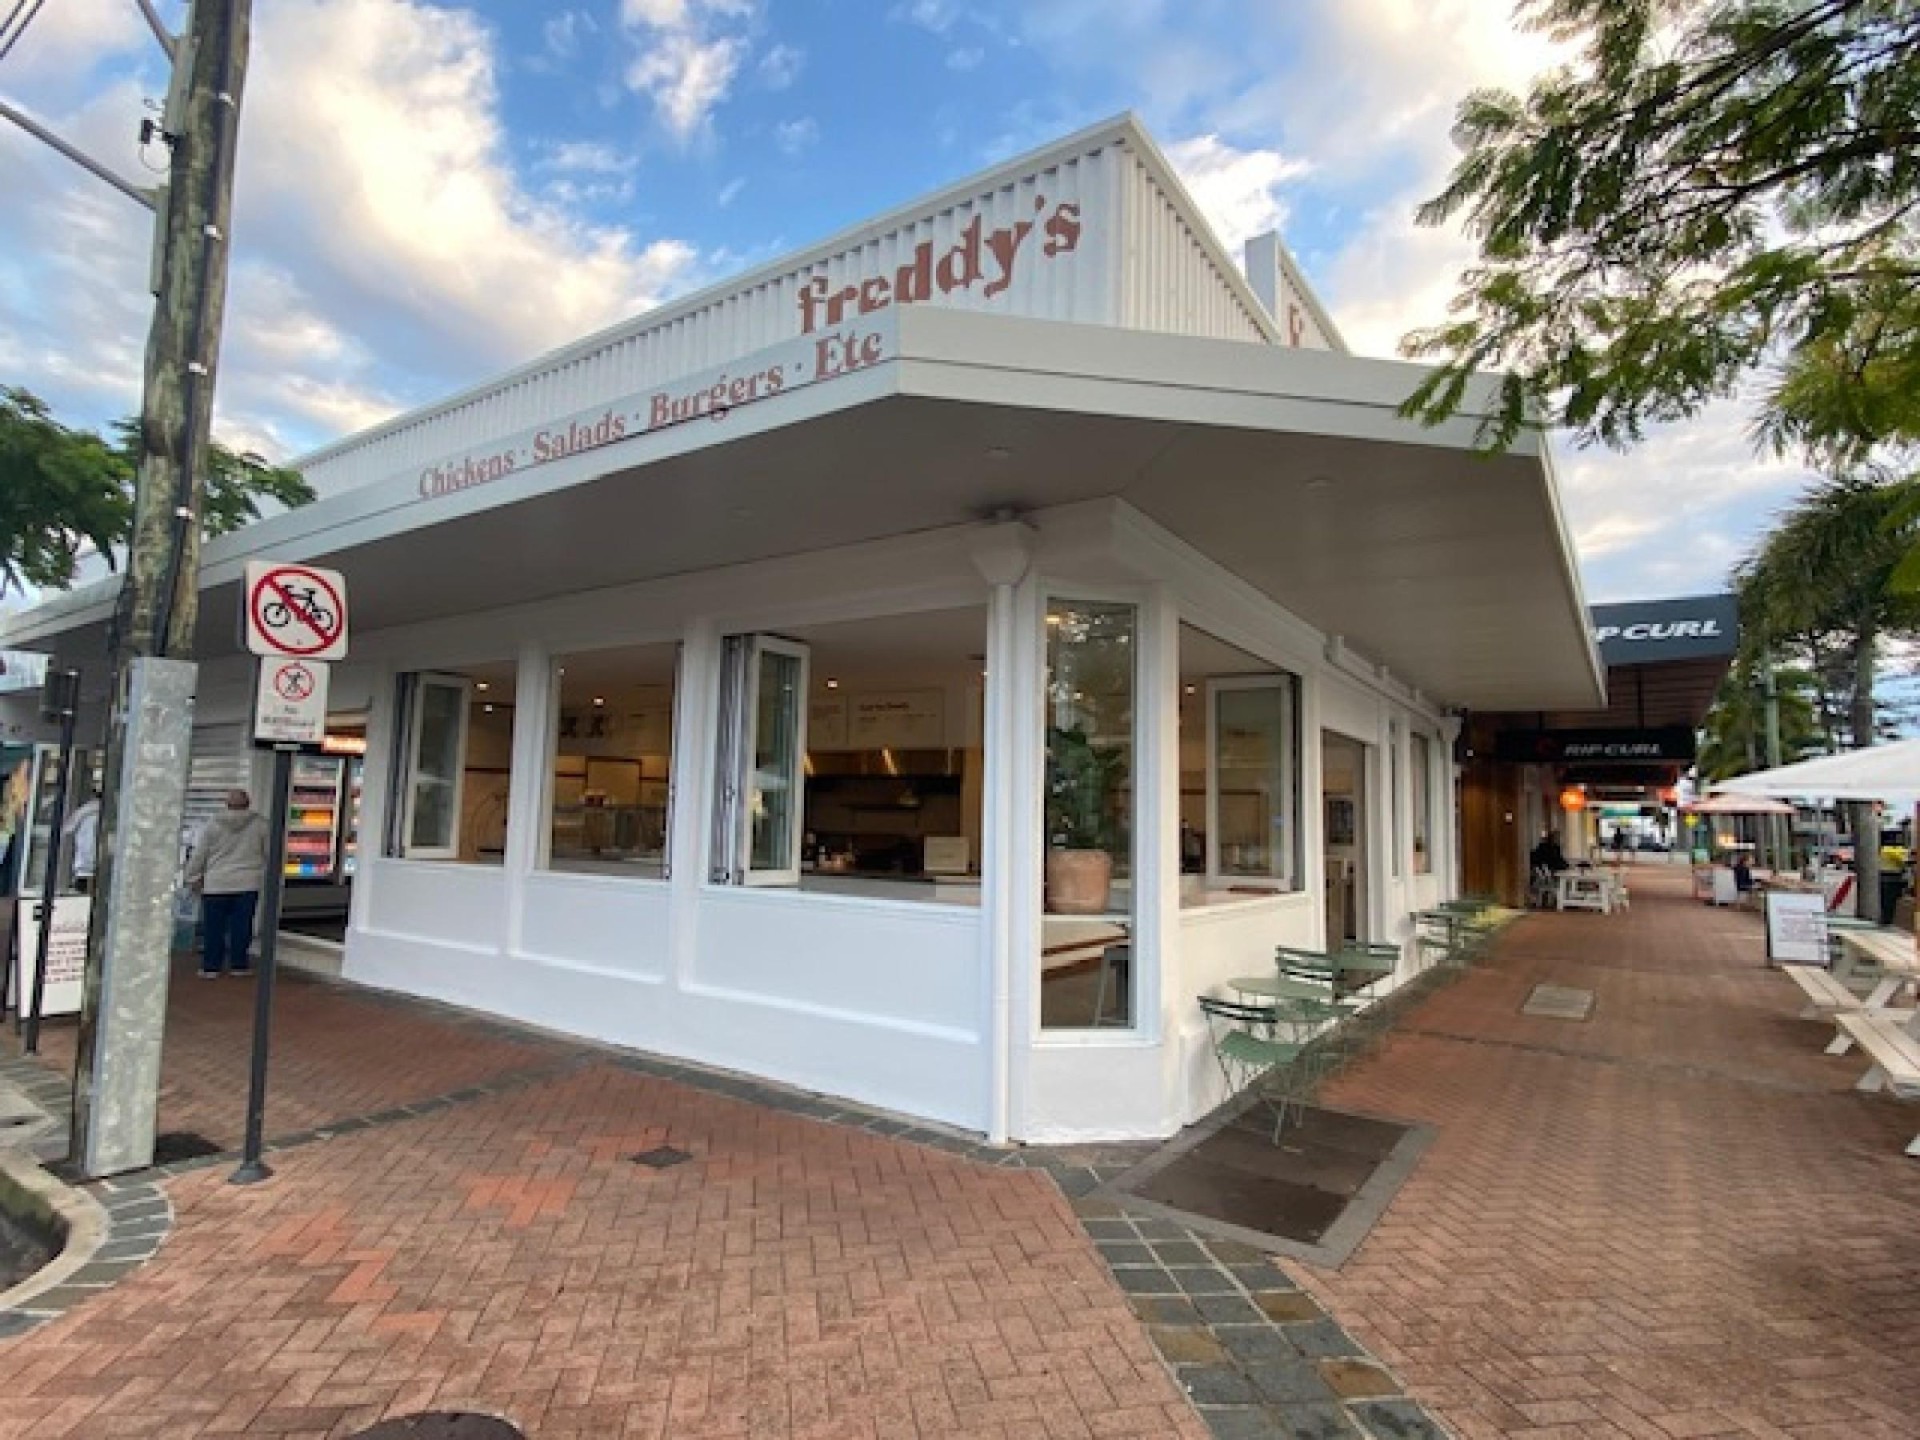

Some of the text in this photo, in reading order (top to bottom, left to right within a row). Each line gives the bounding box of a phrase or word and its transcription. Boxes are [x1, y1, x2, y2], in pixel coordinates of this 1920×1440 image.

[798, 194, 1081, 333] freddy's
[419, 331, 882, 499] Chickens Salads Burgers Etc
[1622, 618, 1722, 640] CURL
